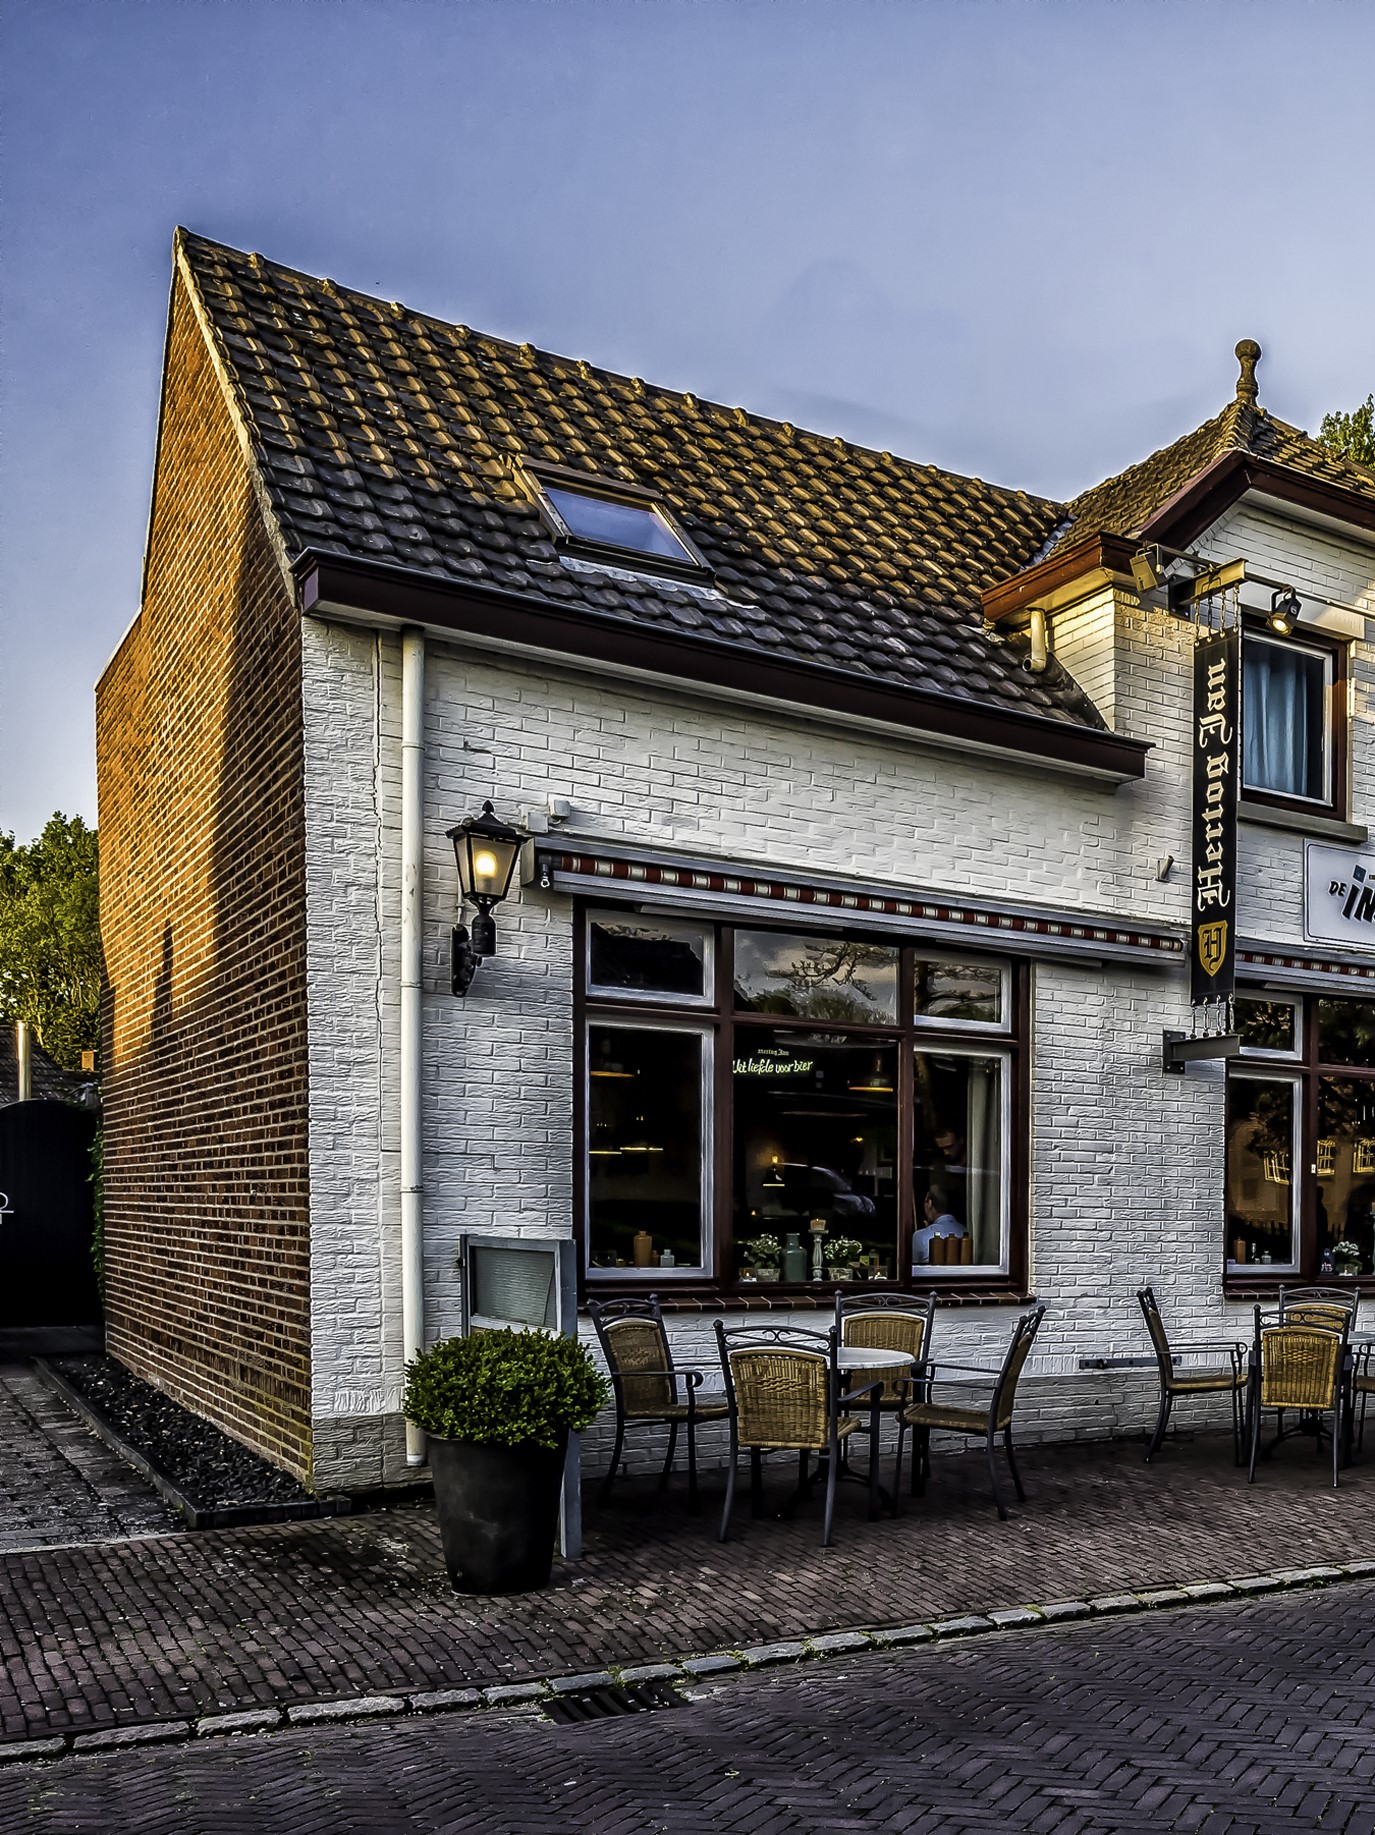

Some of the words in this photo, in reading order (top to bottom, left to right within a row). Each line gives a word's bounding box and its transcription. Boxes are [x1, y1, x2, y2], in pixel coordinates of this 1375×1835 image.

[1199, 657, 1232, 748] Jan
[1197, 751, 1230, 911] Hertog
[1329, 880, 1347, 897] DE
[747, 1057, 775, 1075] liefde
[775, 1062, 794, 1074] voor
[793, 1059, 814, 1072] bier
